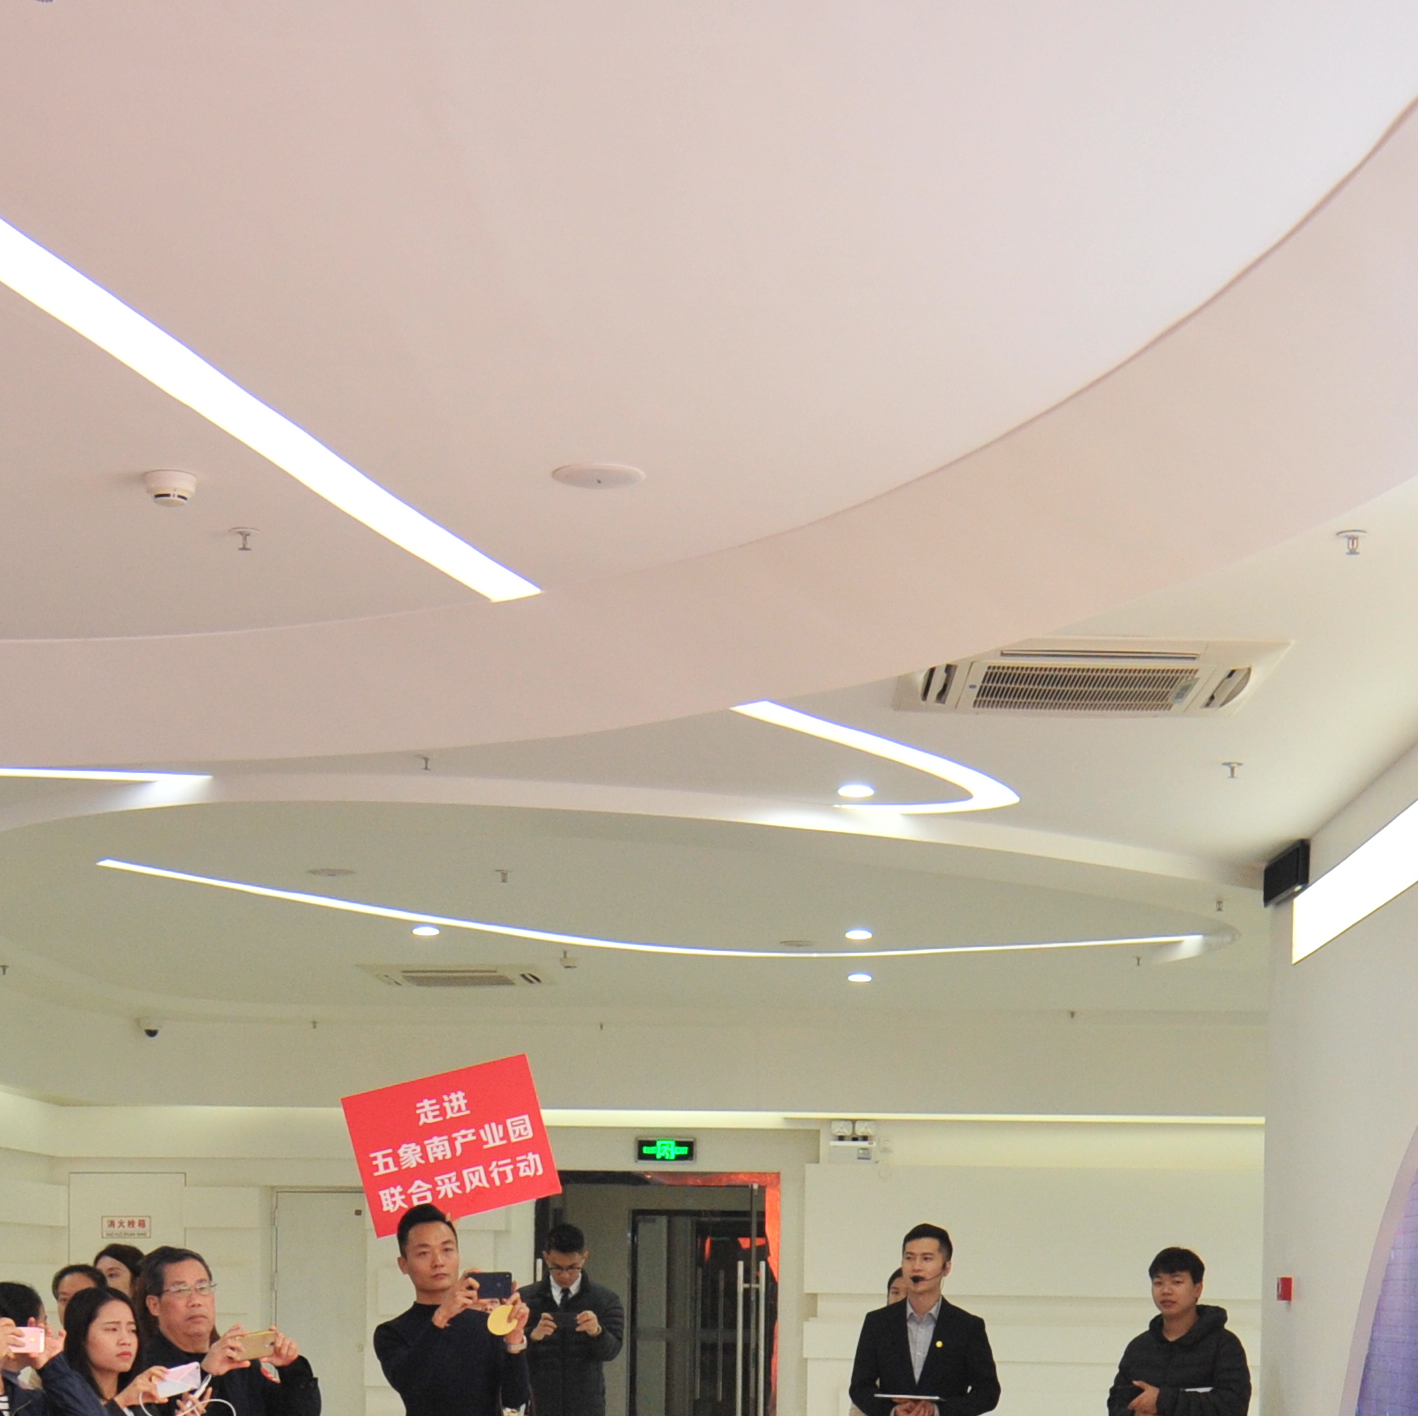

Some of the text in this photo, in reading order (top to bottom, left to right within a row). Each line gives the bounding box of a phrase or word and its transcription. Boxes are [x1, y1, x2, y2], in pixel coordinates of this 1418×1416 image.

[415, 1090, 471, 1126] 走进
[369, 1114, 534, 1176] 五象南产业园
[378, 1152, 544, 1213] 联合采风行动
